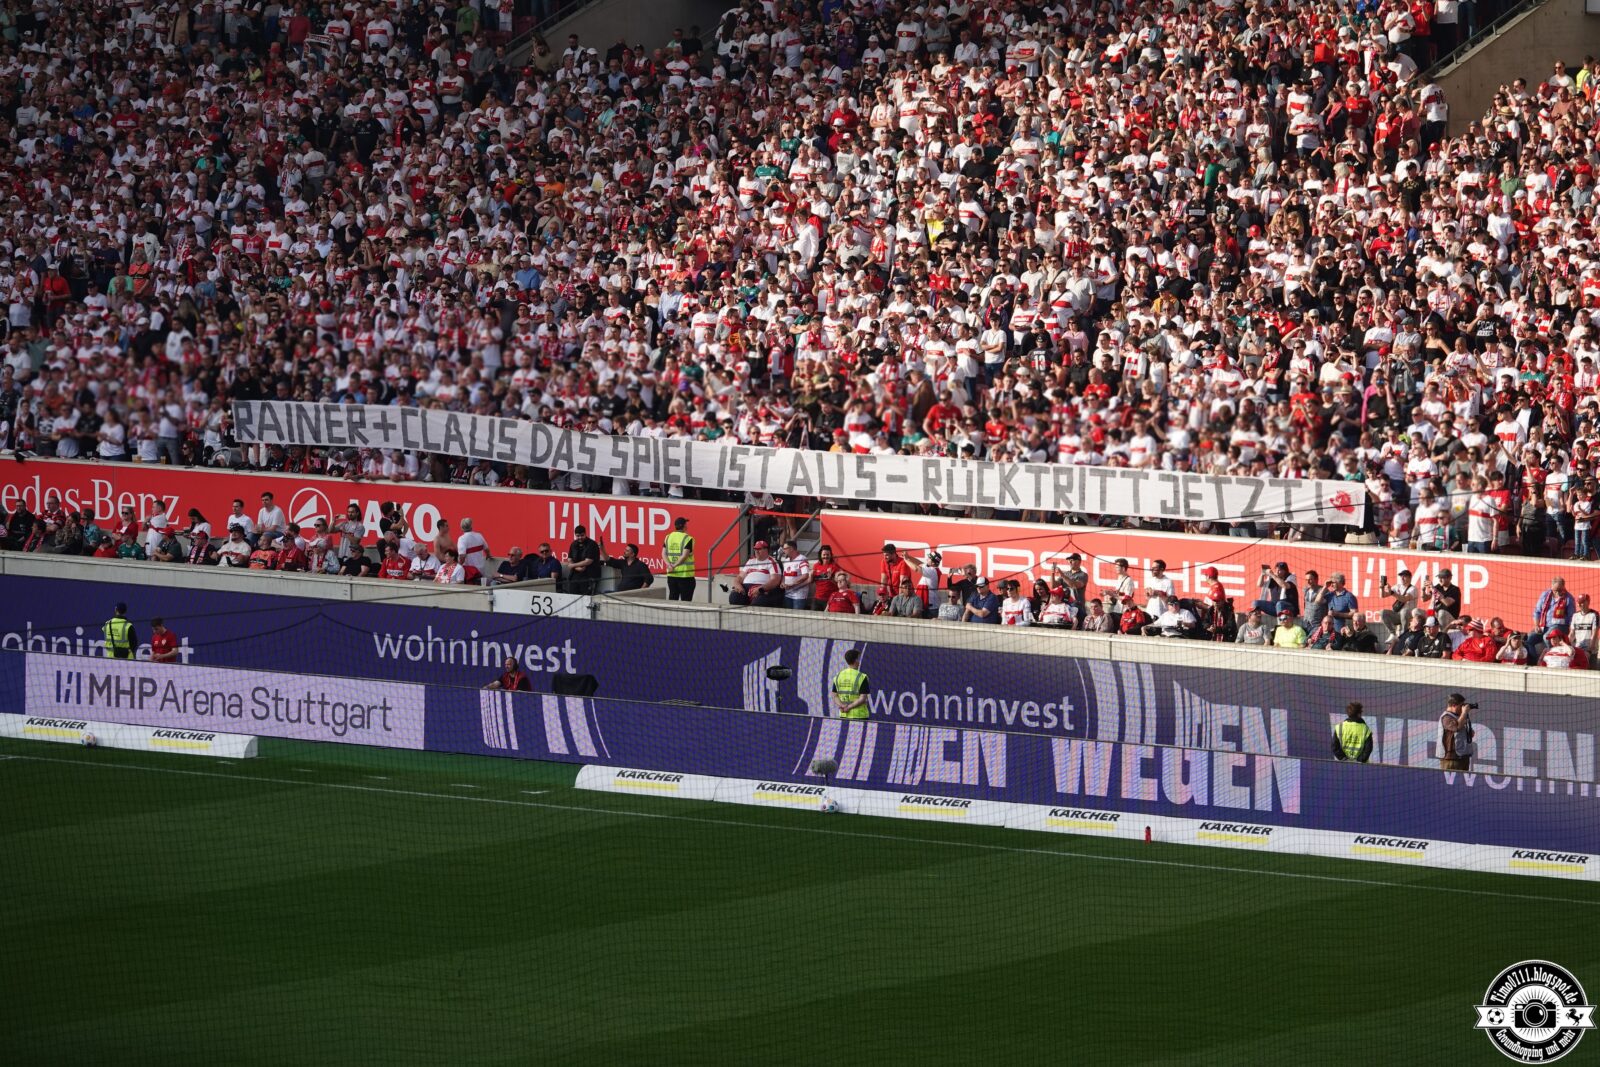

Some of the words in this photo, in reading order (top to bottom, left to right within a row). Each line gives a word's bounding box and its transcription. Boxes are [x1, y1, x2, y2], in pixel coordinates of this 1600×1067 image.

[530, 423, 597, 472] DAS
[609, 434, 704, 486] SPIEL
[717, 445, 777, 489] IST
[786, 450, 878, 498] AUS
[922, 458, 1149, 515] RÜCKTRITT
[1158, 473, 1325, 523] JETZT!
[349, 498, 442, 543] AKO
[589, 503, 671, 546] MHP
[530, 595, 553, 616] 53
[373, 625, 577, 675] wohninvest
[251, 686, 393, 737] Stuttgart
[868, 681, 1075, 731] wohninvest
[1052, 737, 1301, 815] WEGEN
